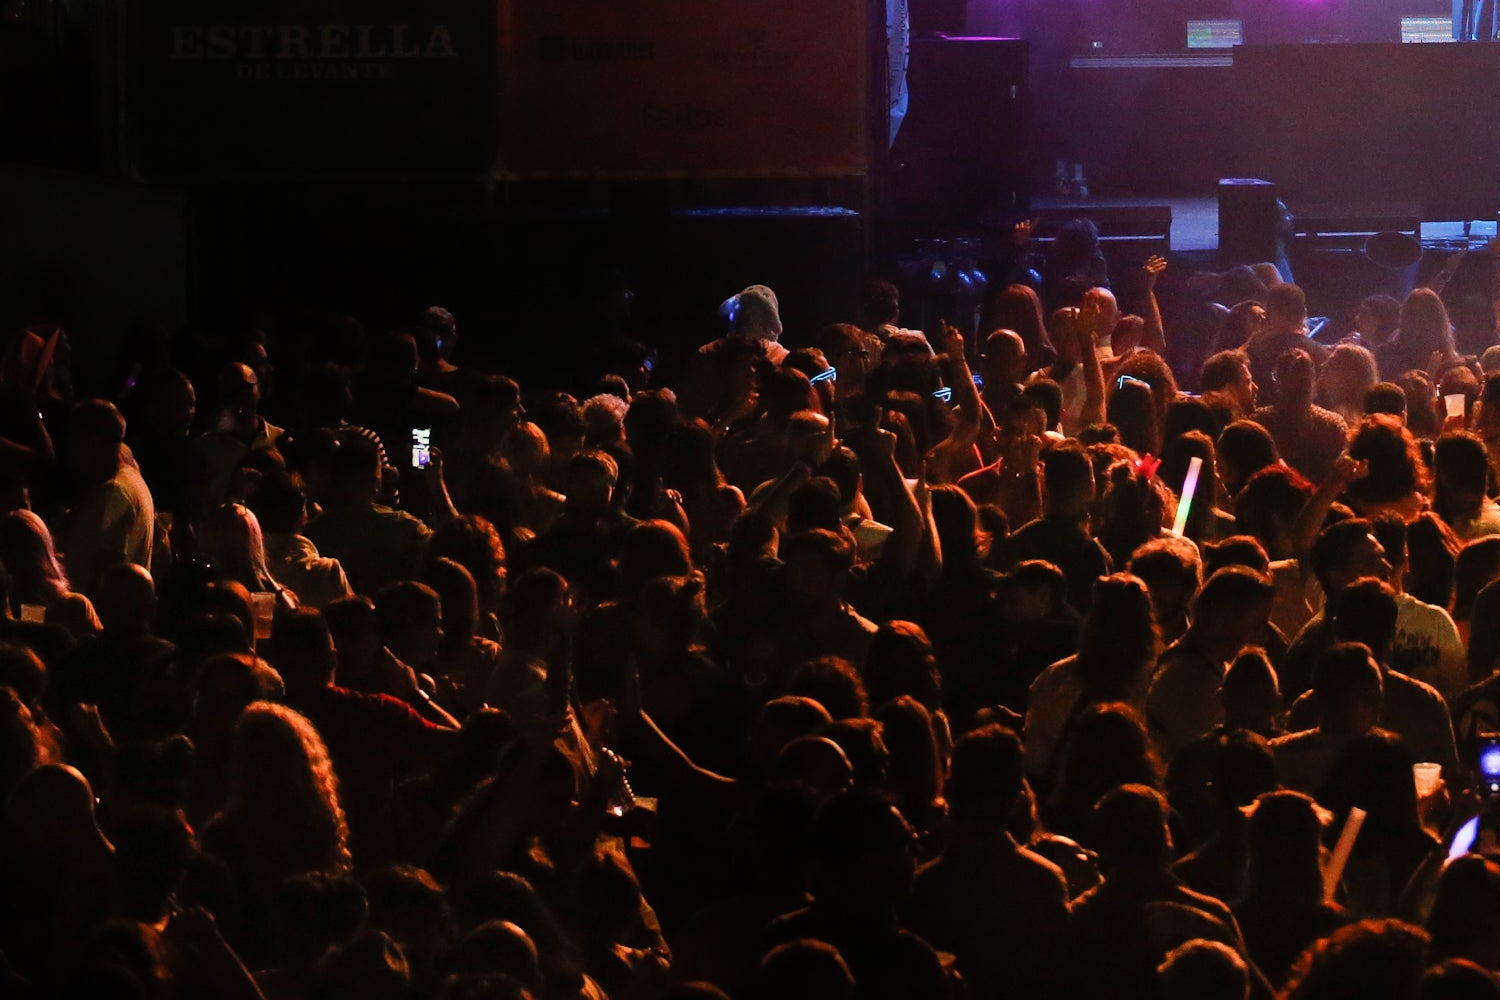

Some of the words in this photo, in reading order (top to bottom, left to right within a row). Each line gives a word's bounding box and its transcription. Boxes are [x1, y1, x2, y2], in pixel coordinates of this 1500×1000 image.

[168, 23, 459, 61] ESTRELLA
[235, 62, 270, 80] DE
[276, 62, 396, 80] LEVANTE
